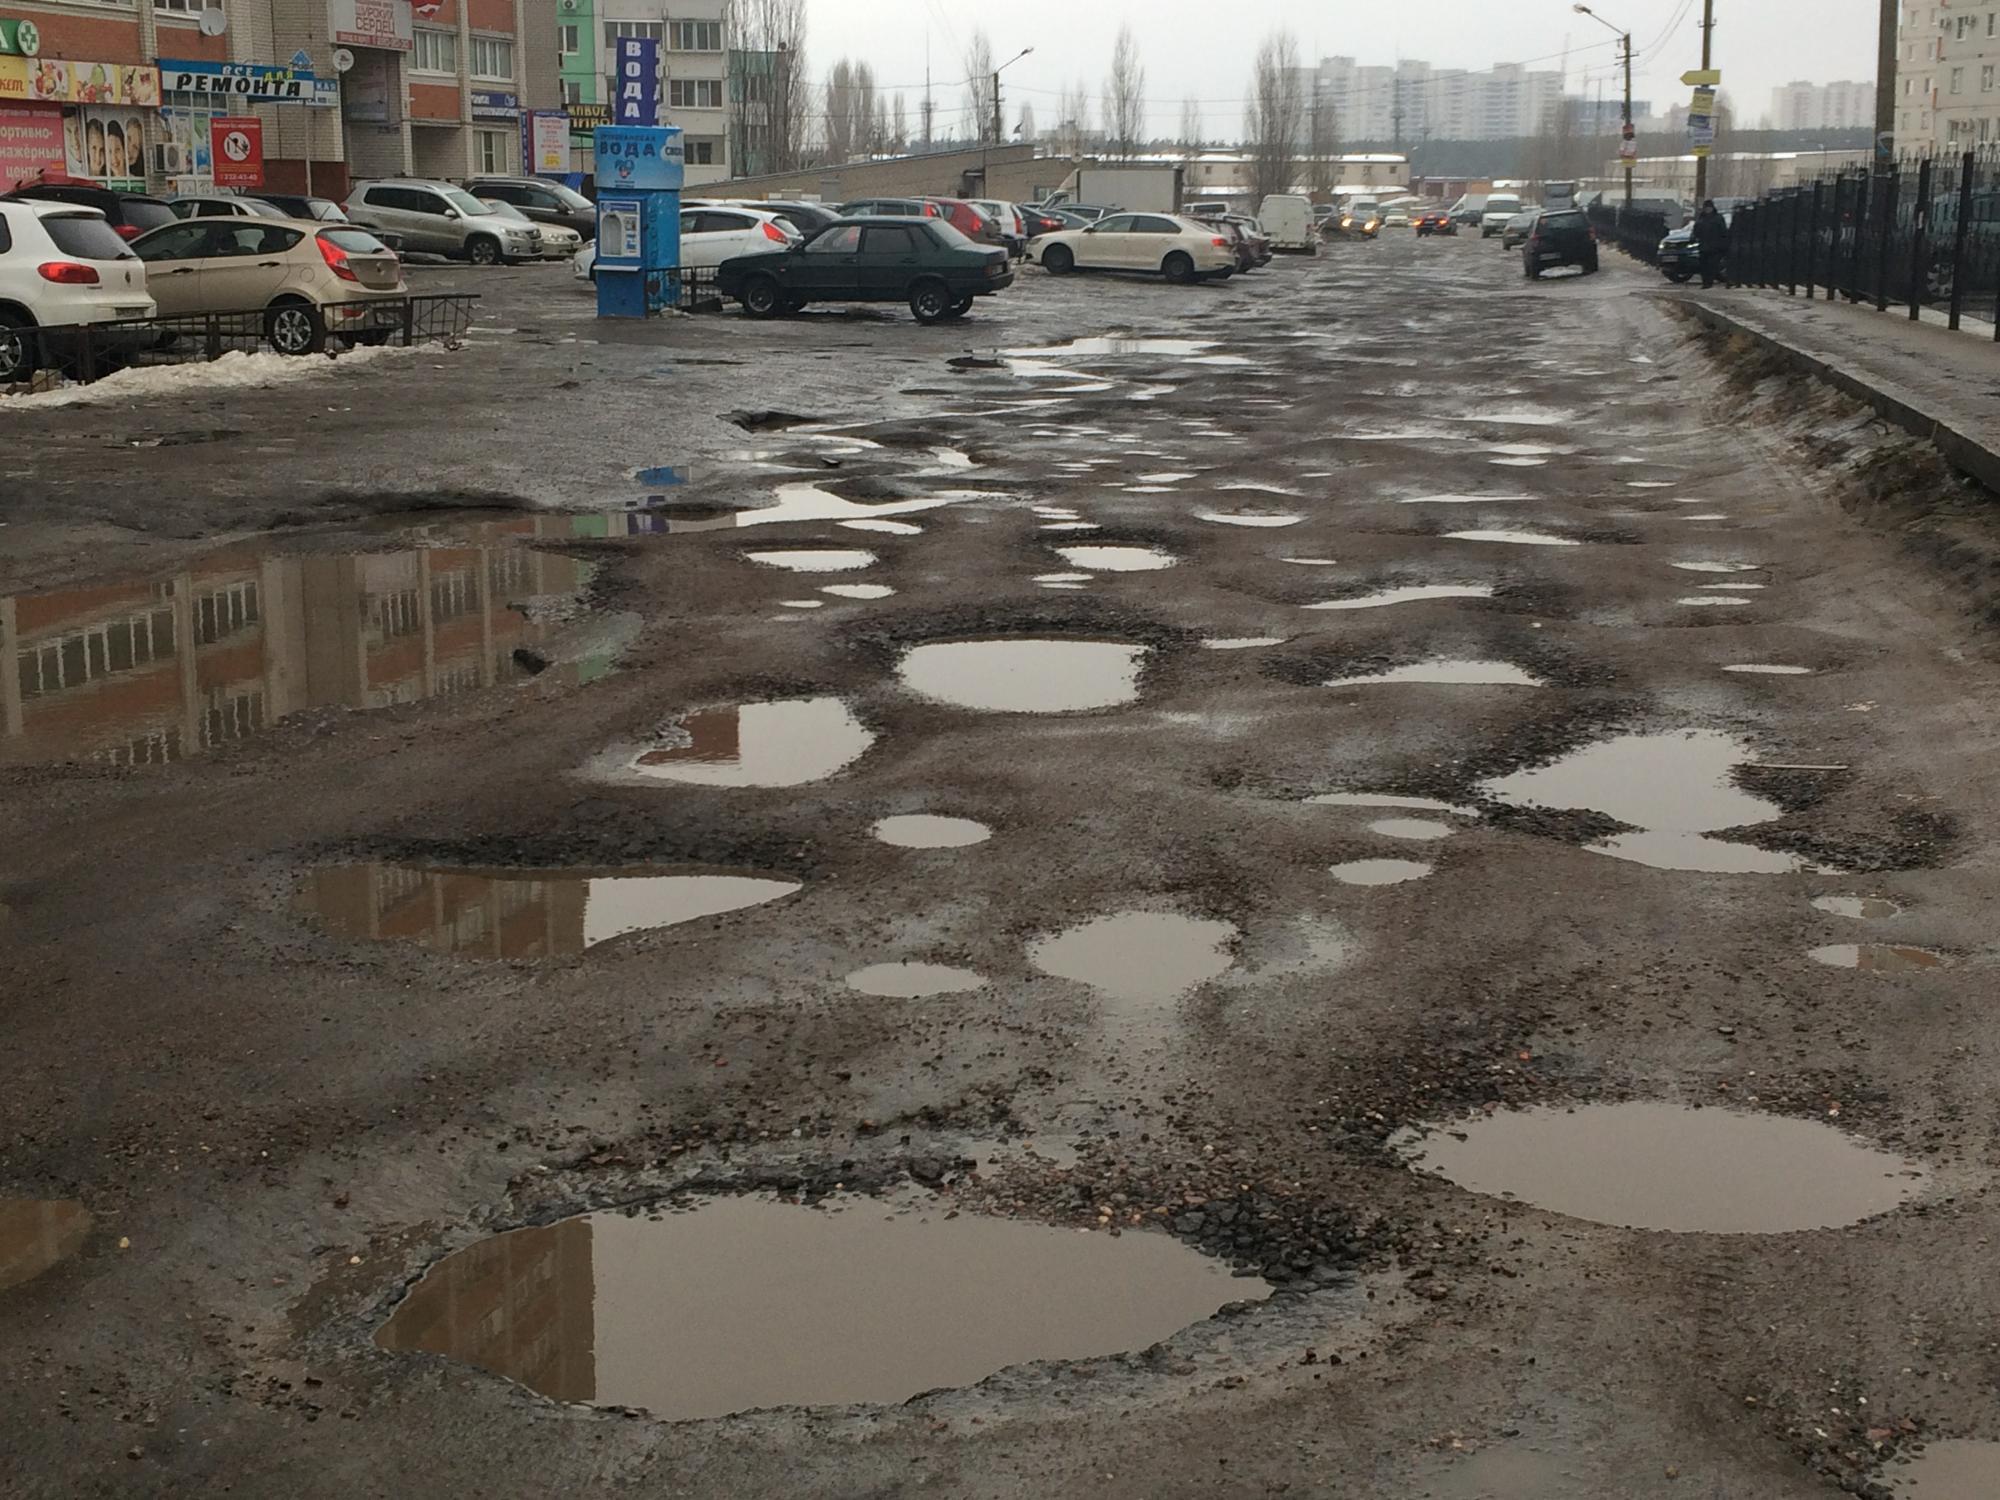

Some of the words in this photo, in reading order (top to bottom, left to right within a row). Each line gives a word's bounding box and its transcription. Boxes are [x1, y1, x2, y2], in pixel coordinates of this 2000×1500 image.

[355, 17, 395, 36] СЕРДЕЦ
[222, 64, 255, 77] ВСЕ
[263, 69, 294, 83] ДЛЯ
[623, 41, 642, 118] ВОДА
[176, 73, 301, 97] РЕМОНТА
[0, 126, 53, 141] ортивно-
[600, 141, 656, 158] ВОДА
